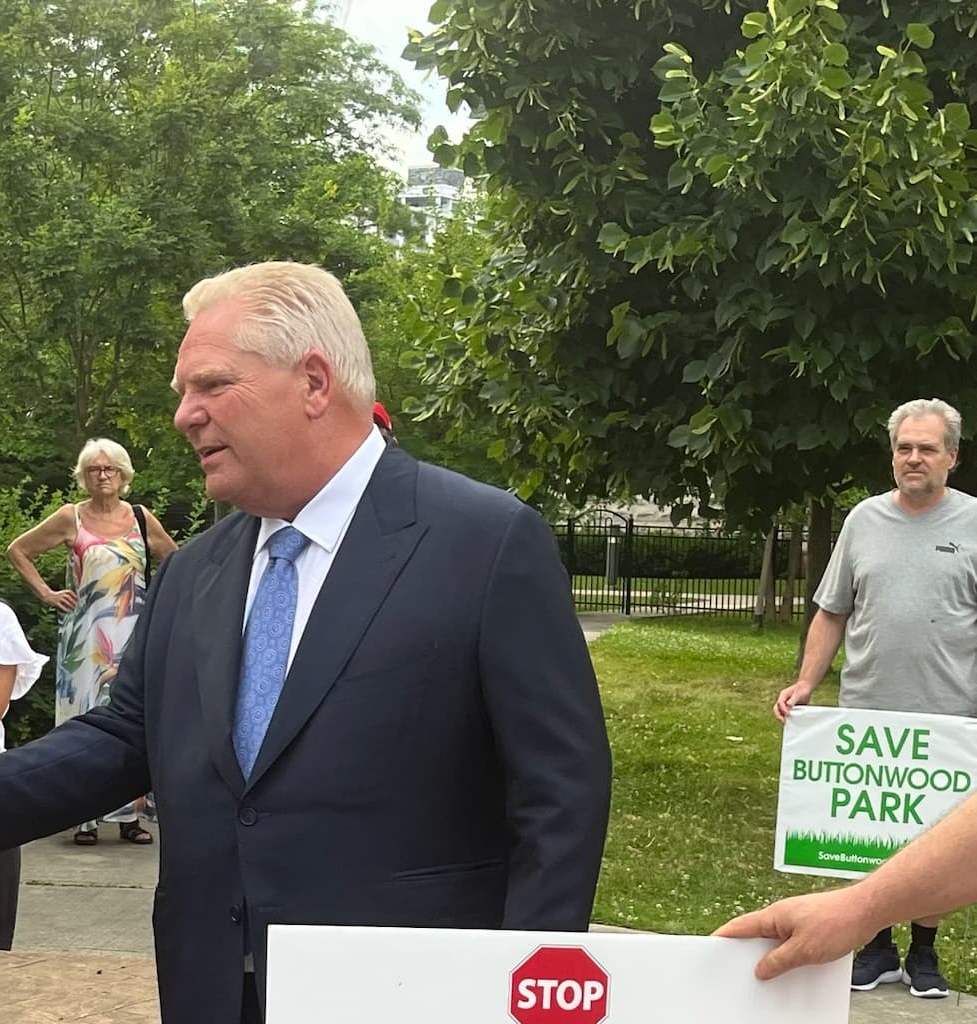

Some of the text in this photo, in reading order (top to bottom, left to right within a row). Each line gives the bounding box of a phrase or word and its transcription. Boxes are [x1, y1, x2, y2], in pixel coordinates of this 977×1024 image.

[836, 724, 930, 760] SAVE
[793, 760, 971, 792] BUTTONWOOD
[831, 788, 926, 824] PARK
[518, 979, 603, 1010] STOP
